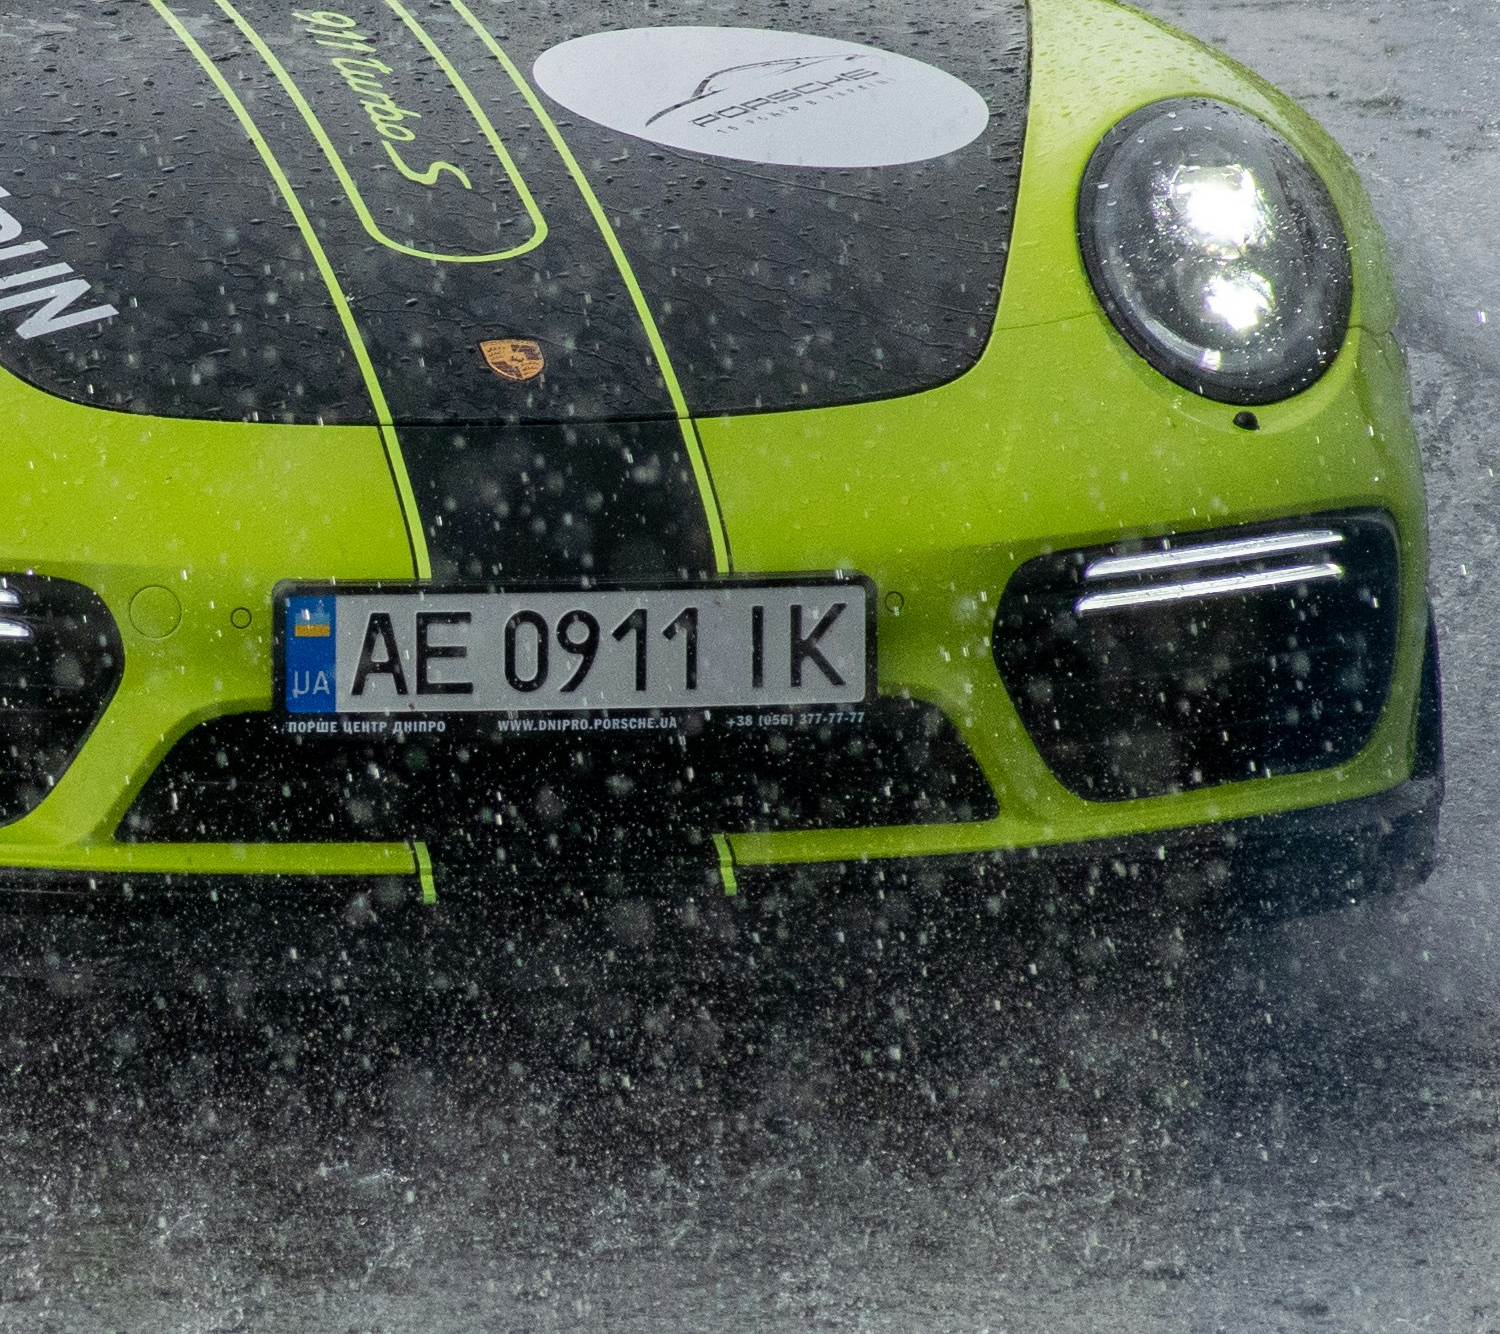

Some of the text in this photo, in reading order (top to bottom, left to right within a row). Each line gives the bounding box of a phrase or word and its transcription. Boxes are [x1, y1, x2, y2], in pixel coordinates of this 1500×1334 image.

[291, 10, 472, 189] 911 turbo S
[688, 68, 879, 127] PORSCHE
[351, 603, 847, 696] AE 0911 IK
[292, 670, 330, 696] UA
[288, 720, 446, 735] ПОРШЕ ЦЕНТР ДНІПРО
[497, 717, 678, 732] WWW.DNIPRO.PORSCHE.UA
[726, 715, 753, 728] +38
